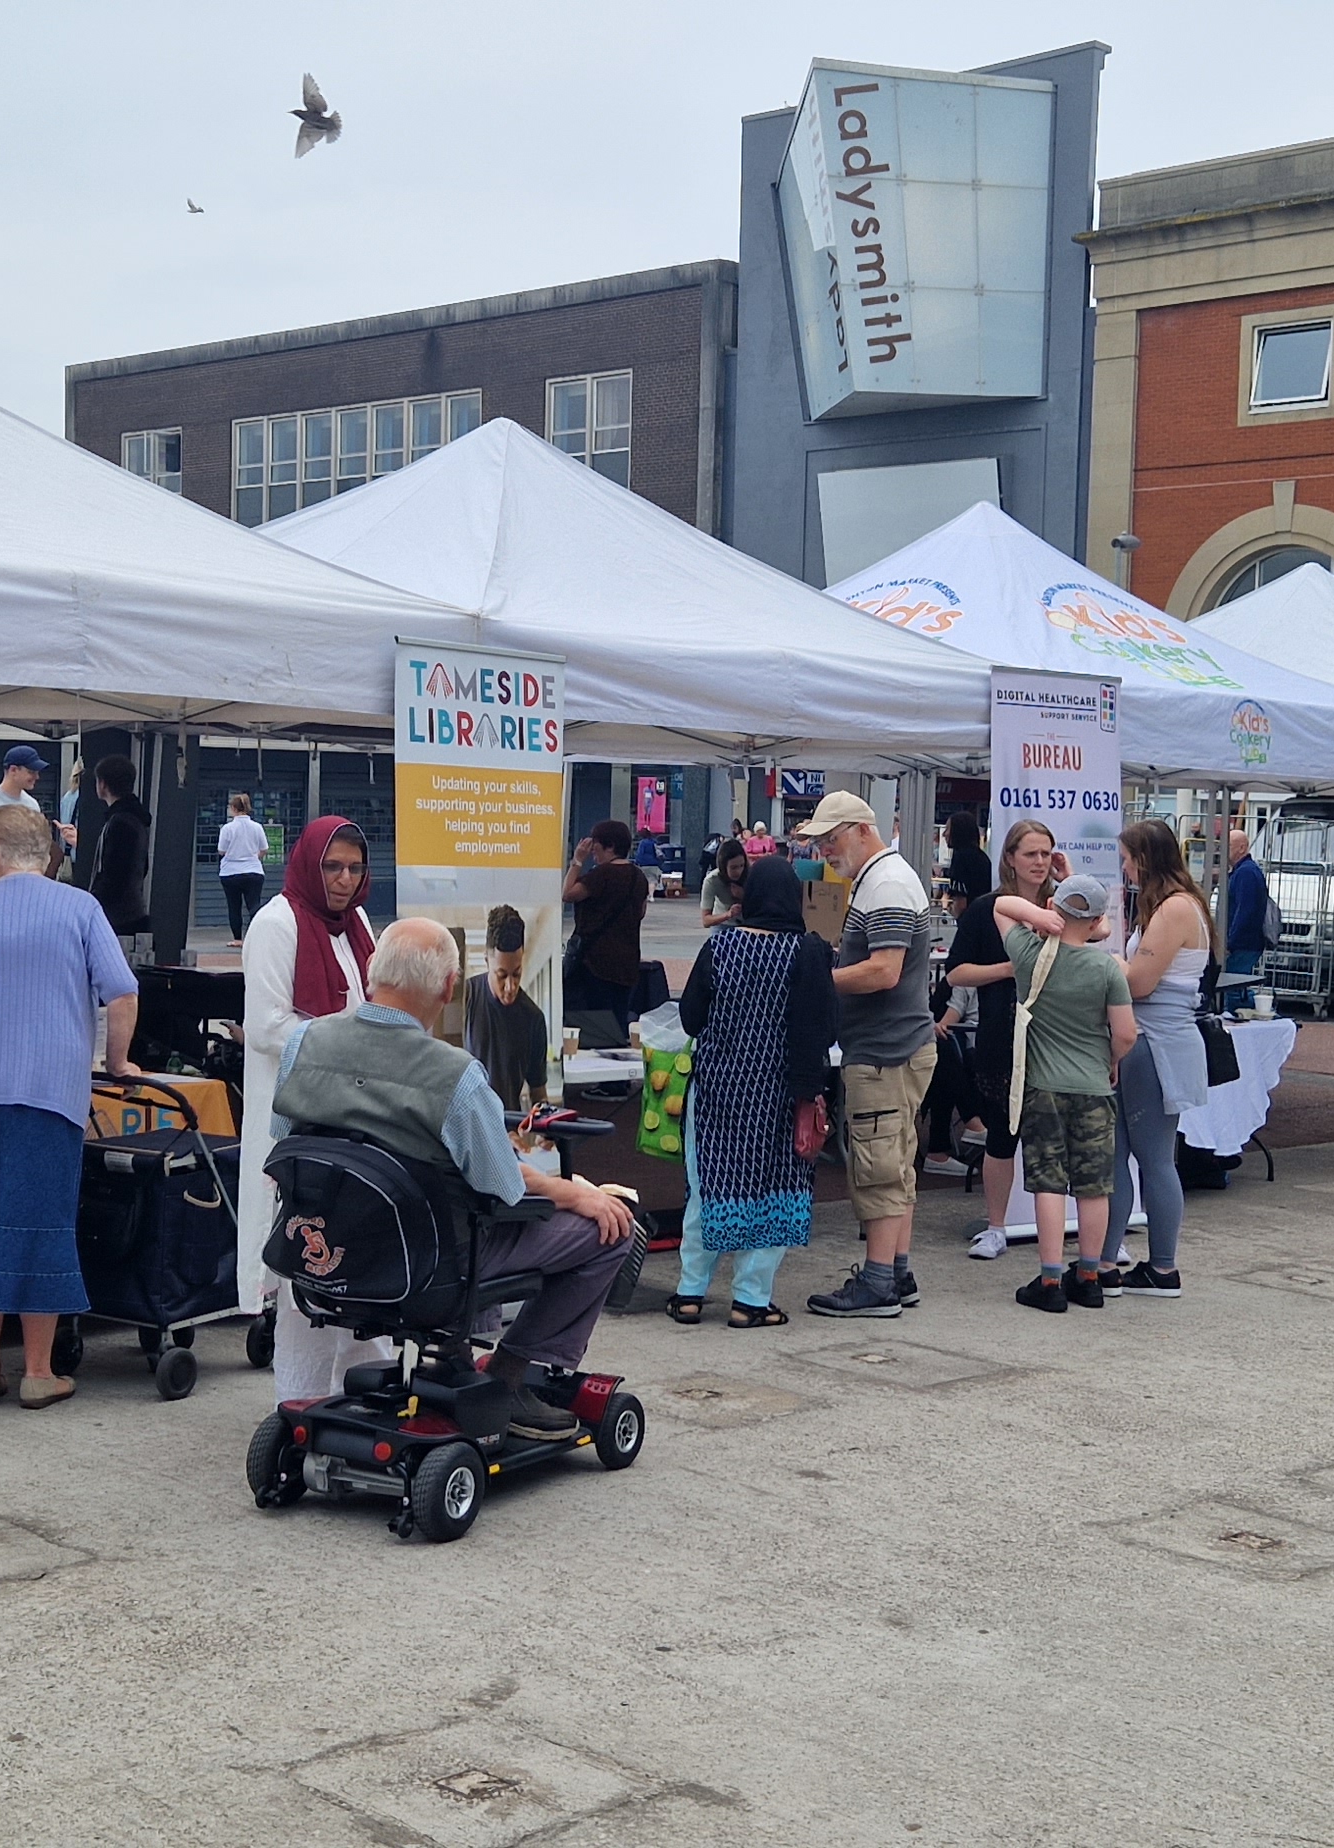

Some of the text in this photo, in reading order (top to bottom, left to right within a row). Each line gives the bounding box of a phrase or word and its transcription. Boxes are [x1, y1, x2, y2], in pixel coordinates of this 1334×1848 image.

[834, 83, 912, 364] Ladysmith
[409, 659, 556, 709] TAMESIDE
[996, 689, 1097, 707] DIGITAL HEALTHCARE
[1040, 712, 1097, 722] SUPPORT SERVICE
[409, 706, 558, 753] LIBRARIES
[1022, 743, 1082, 771] BUREAU
[432, 774, 541, 796] Updating your skills,
[415, 797, 556, 817] supporting your business,
[1000, 787, 1119, 811] 0161 537 0630
[444, 817, 531, 836] helping you find
[454, 839, 521, 856] employment
[1069, 842, 1085, 851] CAN
[1086, 842, 1103, 851] HELP
[1103, 843, 1116, 851] YOU
